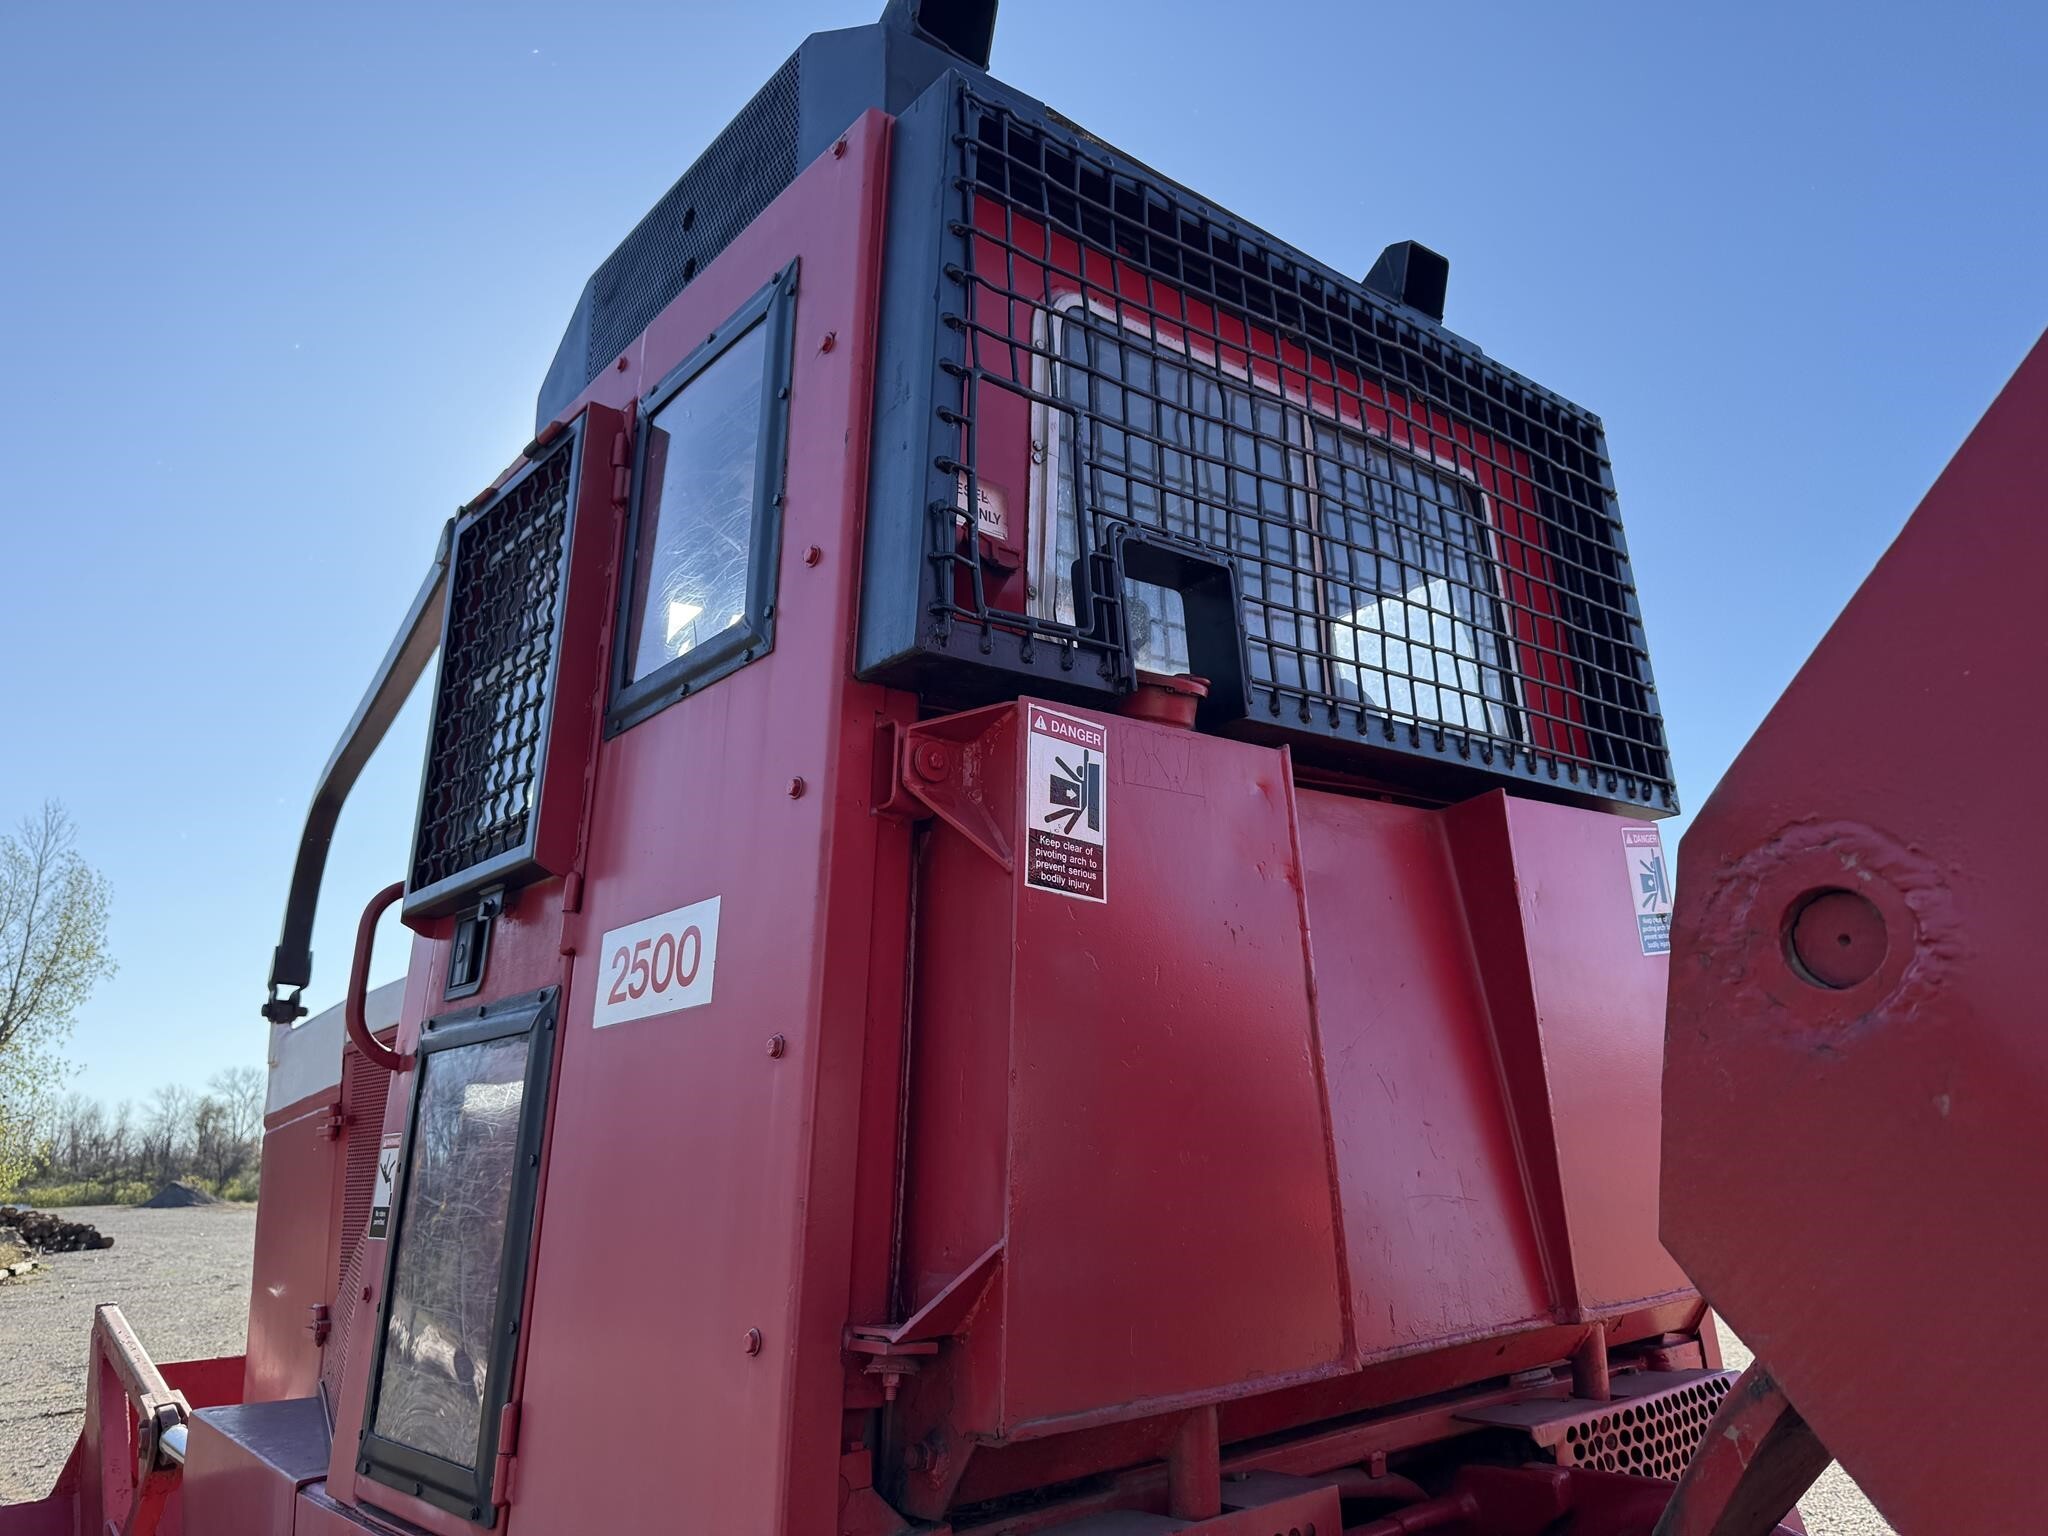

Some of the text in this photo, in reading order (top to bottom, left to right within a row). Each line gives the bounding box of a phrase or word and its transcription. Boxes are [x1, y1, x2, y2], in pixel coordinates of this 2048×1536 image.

[958, 482, 988, 504] ESEL
[979, 508, 1001, 525] NLY
[1051, 720, 1101, 746] DANGER
[1040, 835, 1093, 856] Keep clear of
[1632, 834, 1657, 844] DANGER
[1035, 847, 1097, 868] pivoting arch to
[1035, 860, 1097, 880] prevent serious
[1041, 871, 1092, 892] bodily injury.
[607, 925, 702, 1005] 2500
